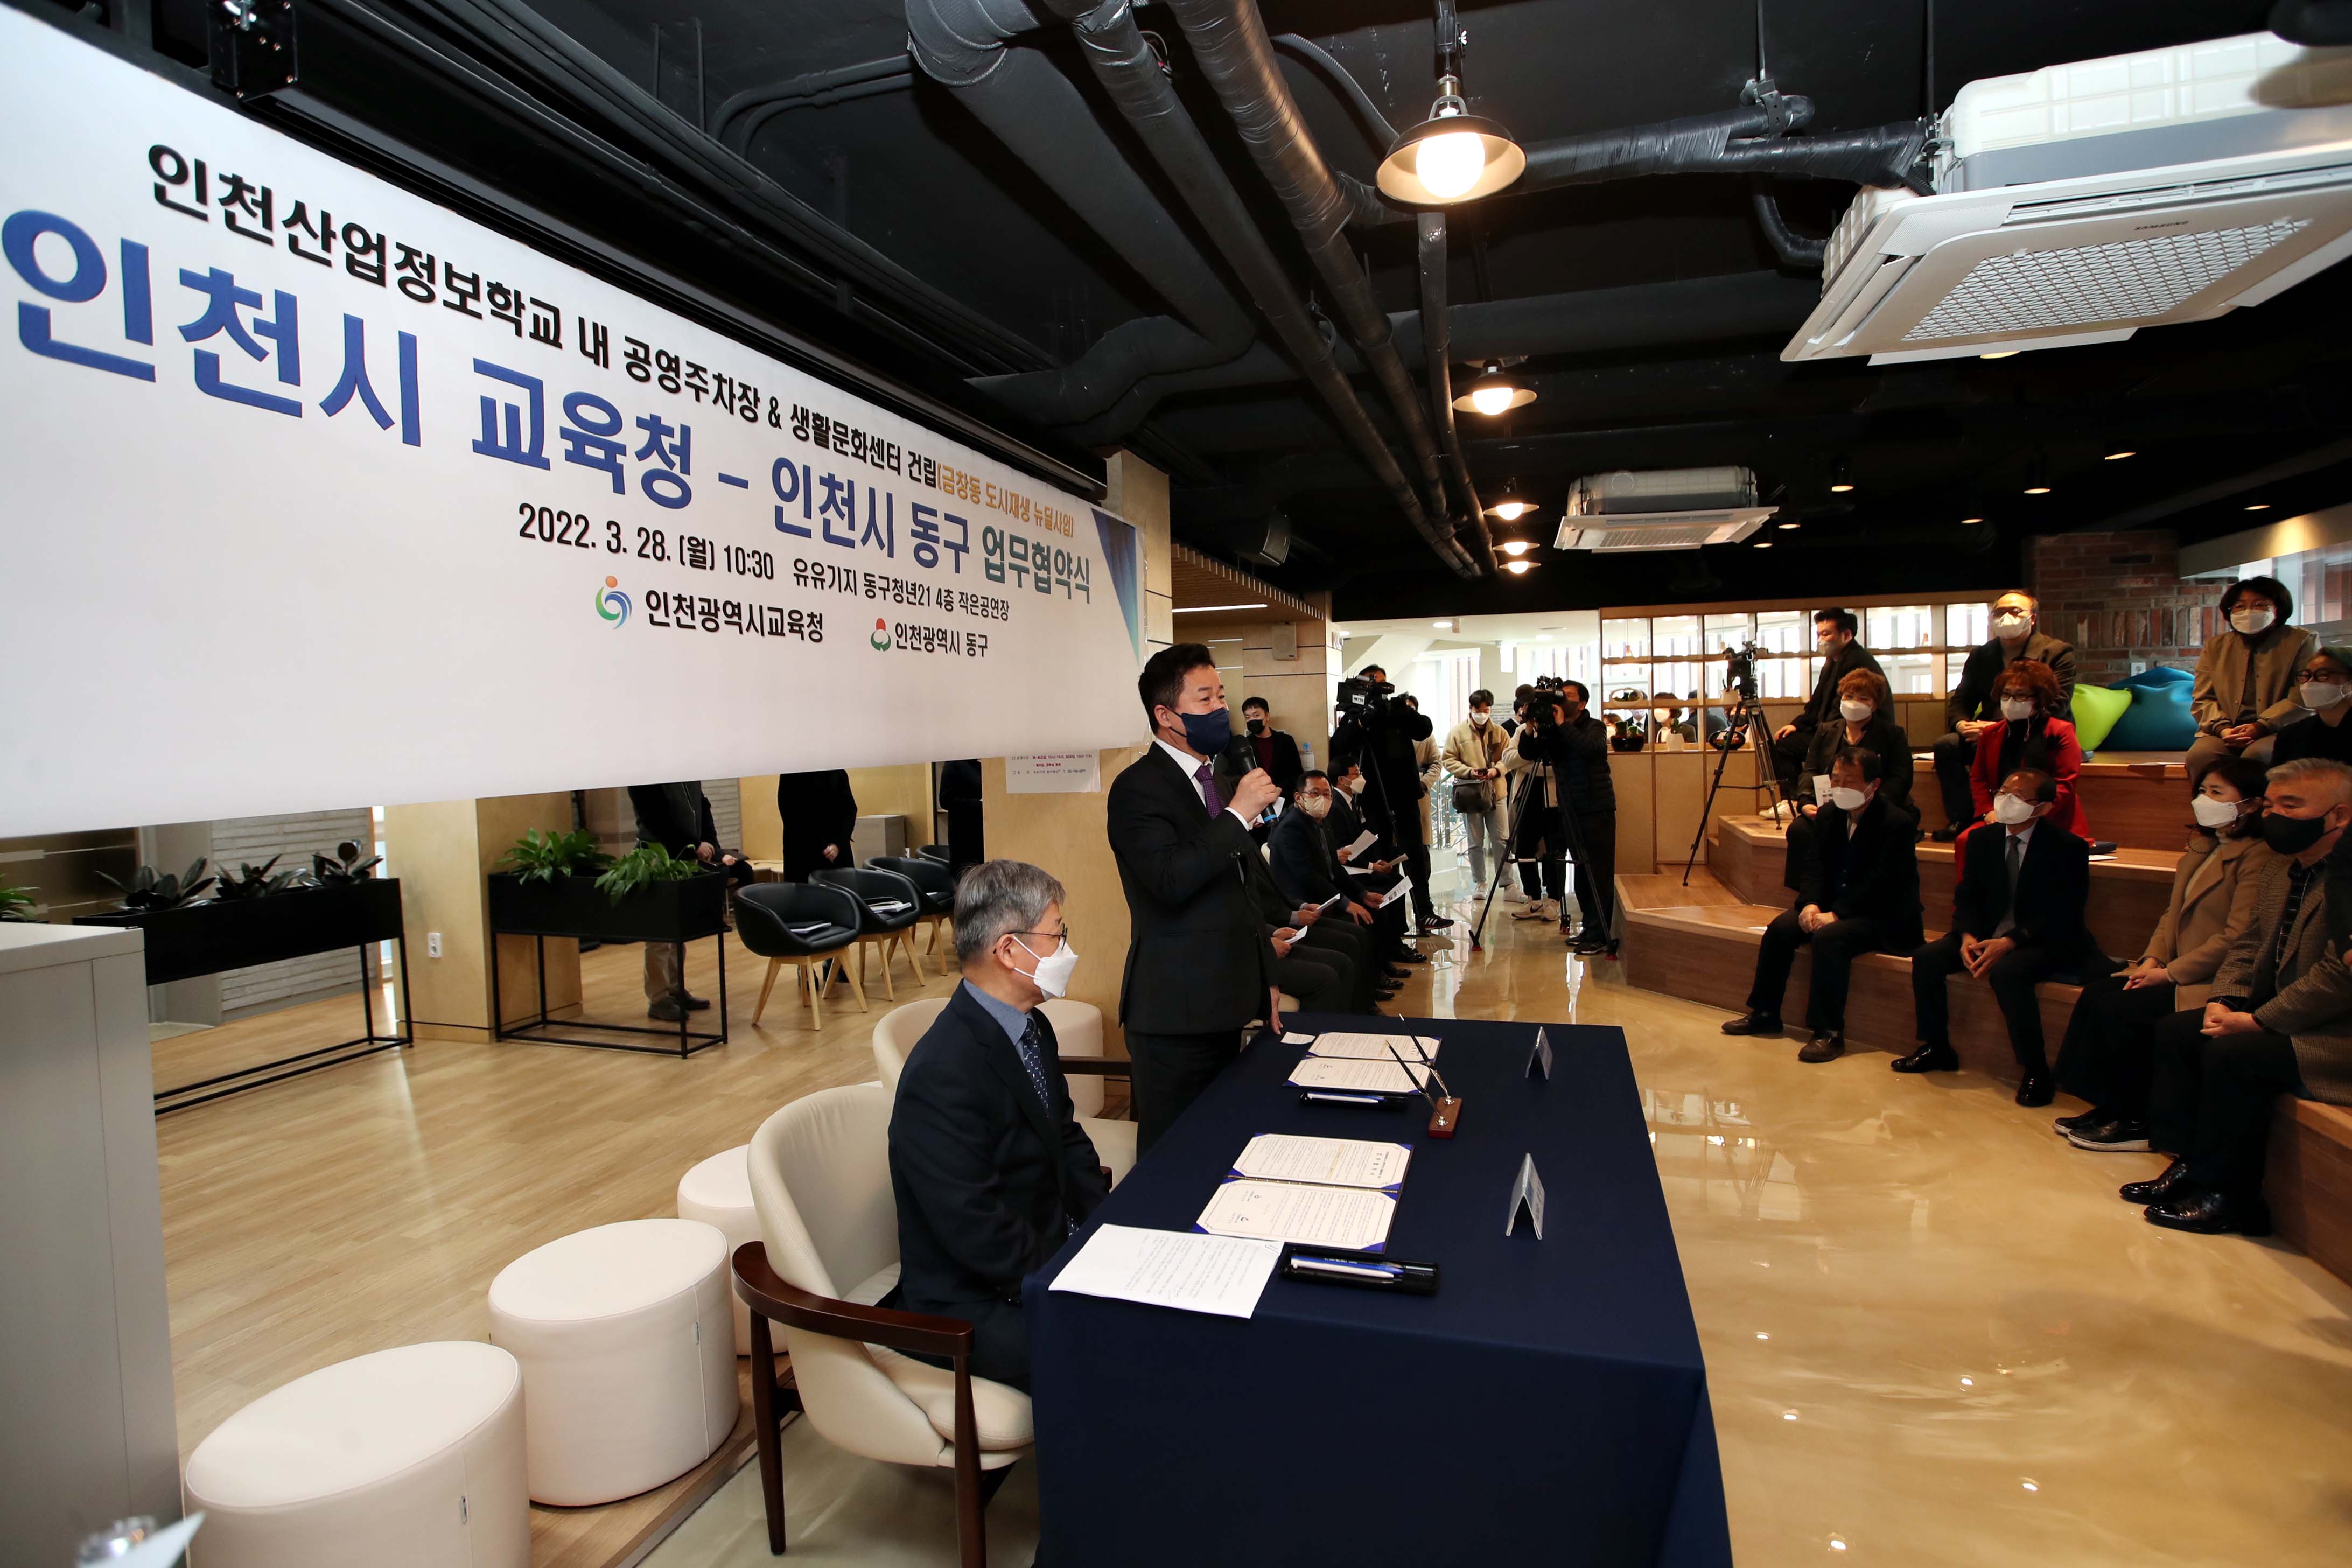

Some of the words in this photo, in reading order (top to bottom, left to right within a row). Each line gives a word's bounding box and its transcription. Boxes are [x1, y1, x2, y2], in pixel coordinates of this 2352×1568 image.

[148, 144, 563, 349] 인천산업정보학교
[578, 316, 608, 369] 내
[624, 335, 760, 424] 공영주차장
[768, 396, 782, 430] &
[790, 403, 901, 477] 생활문화센터
[986, 482, 1030, 522] 도시재생
[1, 209, 421, 447] 인천시
[472, 357, 692, 509] 교육청
[772, 457, 894, 558] 인천시
[911, 501, 969, 574] 동구
[982, 524, 1091, 604] 업무협약식
[519, 502, 596, 548] 2022.
[606, 521, 627, 554] 3.
[637, 527, 671, 561] 28.
[724, 544, 774, 580] 10:30
[793, 558, 857, 597] 유유기지
[864, 572, 930, 607] 동구청년21
[936, 588, 954, 612] 4층
[958, 591, 1010, 621] 작은공연장
[646, 590, 823, 643] 인천광역시교육청
[895, 622, 961, 655] 인천광역시
[966, 632, 988, 657] 동구
